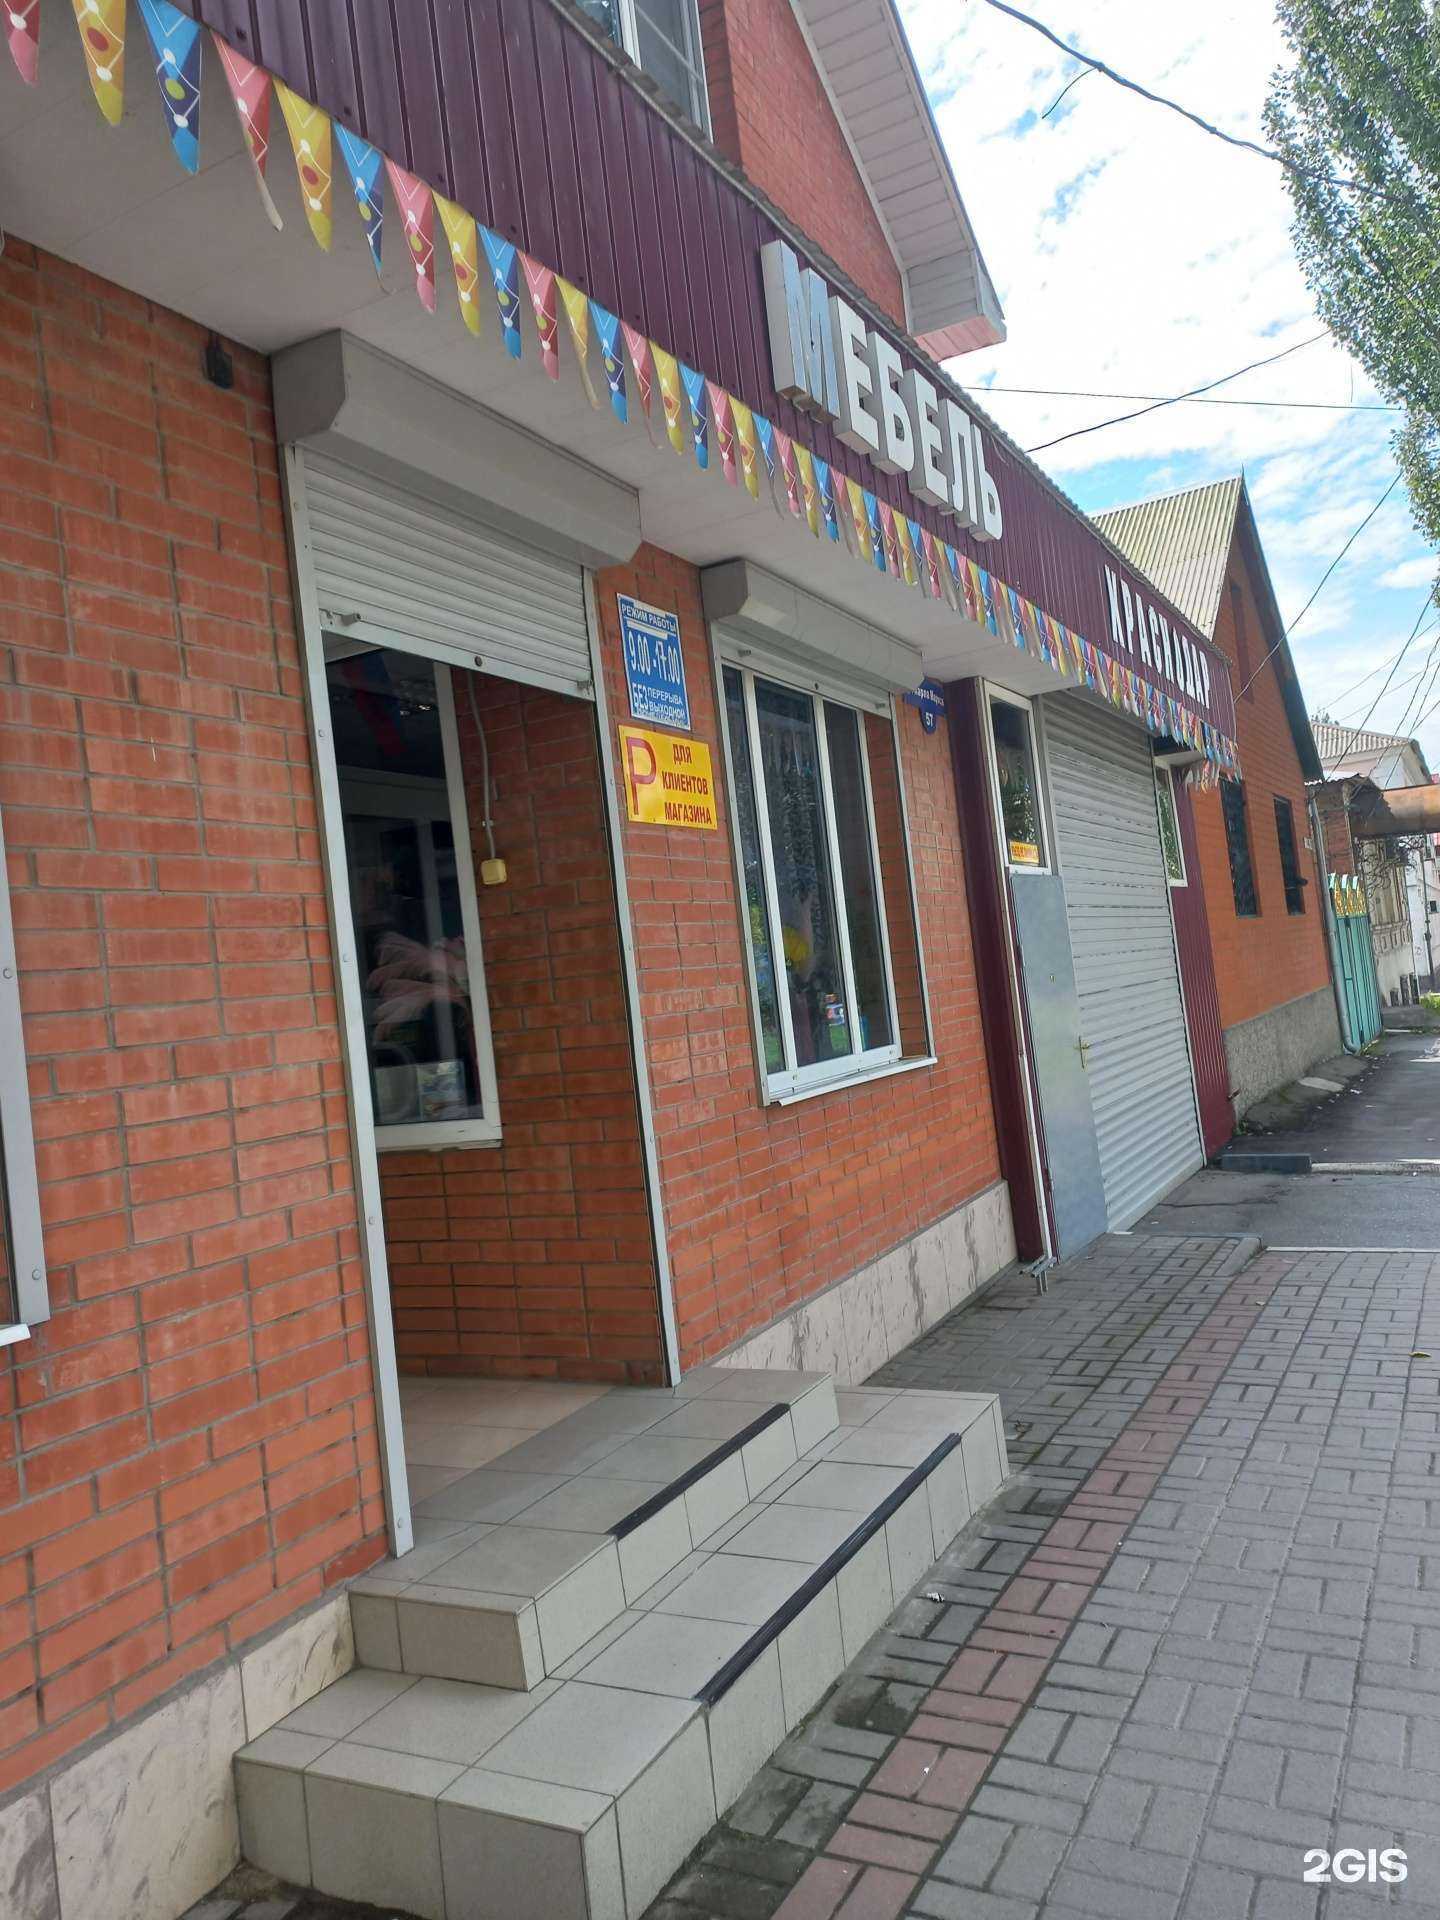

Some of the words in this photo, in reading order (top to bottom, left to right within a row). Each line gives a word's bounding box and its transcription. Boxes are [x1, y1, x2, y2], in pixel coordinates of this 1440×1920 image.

[763, 240, 1003, 541] МЕБЕЛЬ
[621, 603, 647, 622] РЕЖИМ
[648, 613, 677, 634] РАБОТЫ
[1104, 564, 1210, 709] КРАСНОДАР
[632, 682, 649, 710] БЕЗ
[647, 687, 683, 706] ПЕРЕРЫВА
[925, 711, 934, 727] 57
[672, 743, 692, 766] ДЛЯ
[661, 770, 709, 796] КЛИЕНТОВ
[664, 801, 712, 825] МАГАЗИНА
